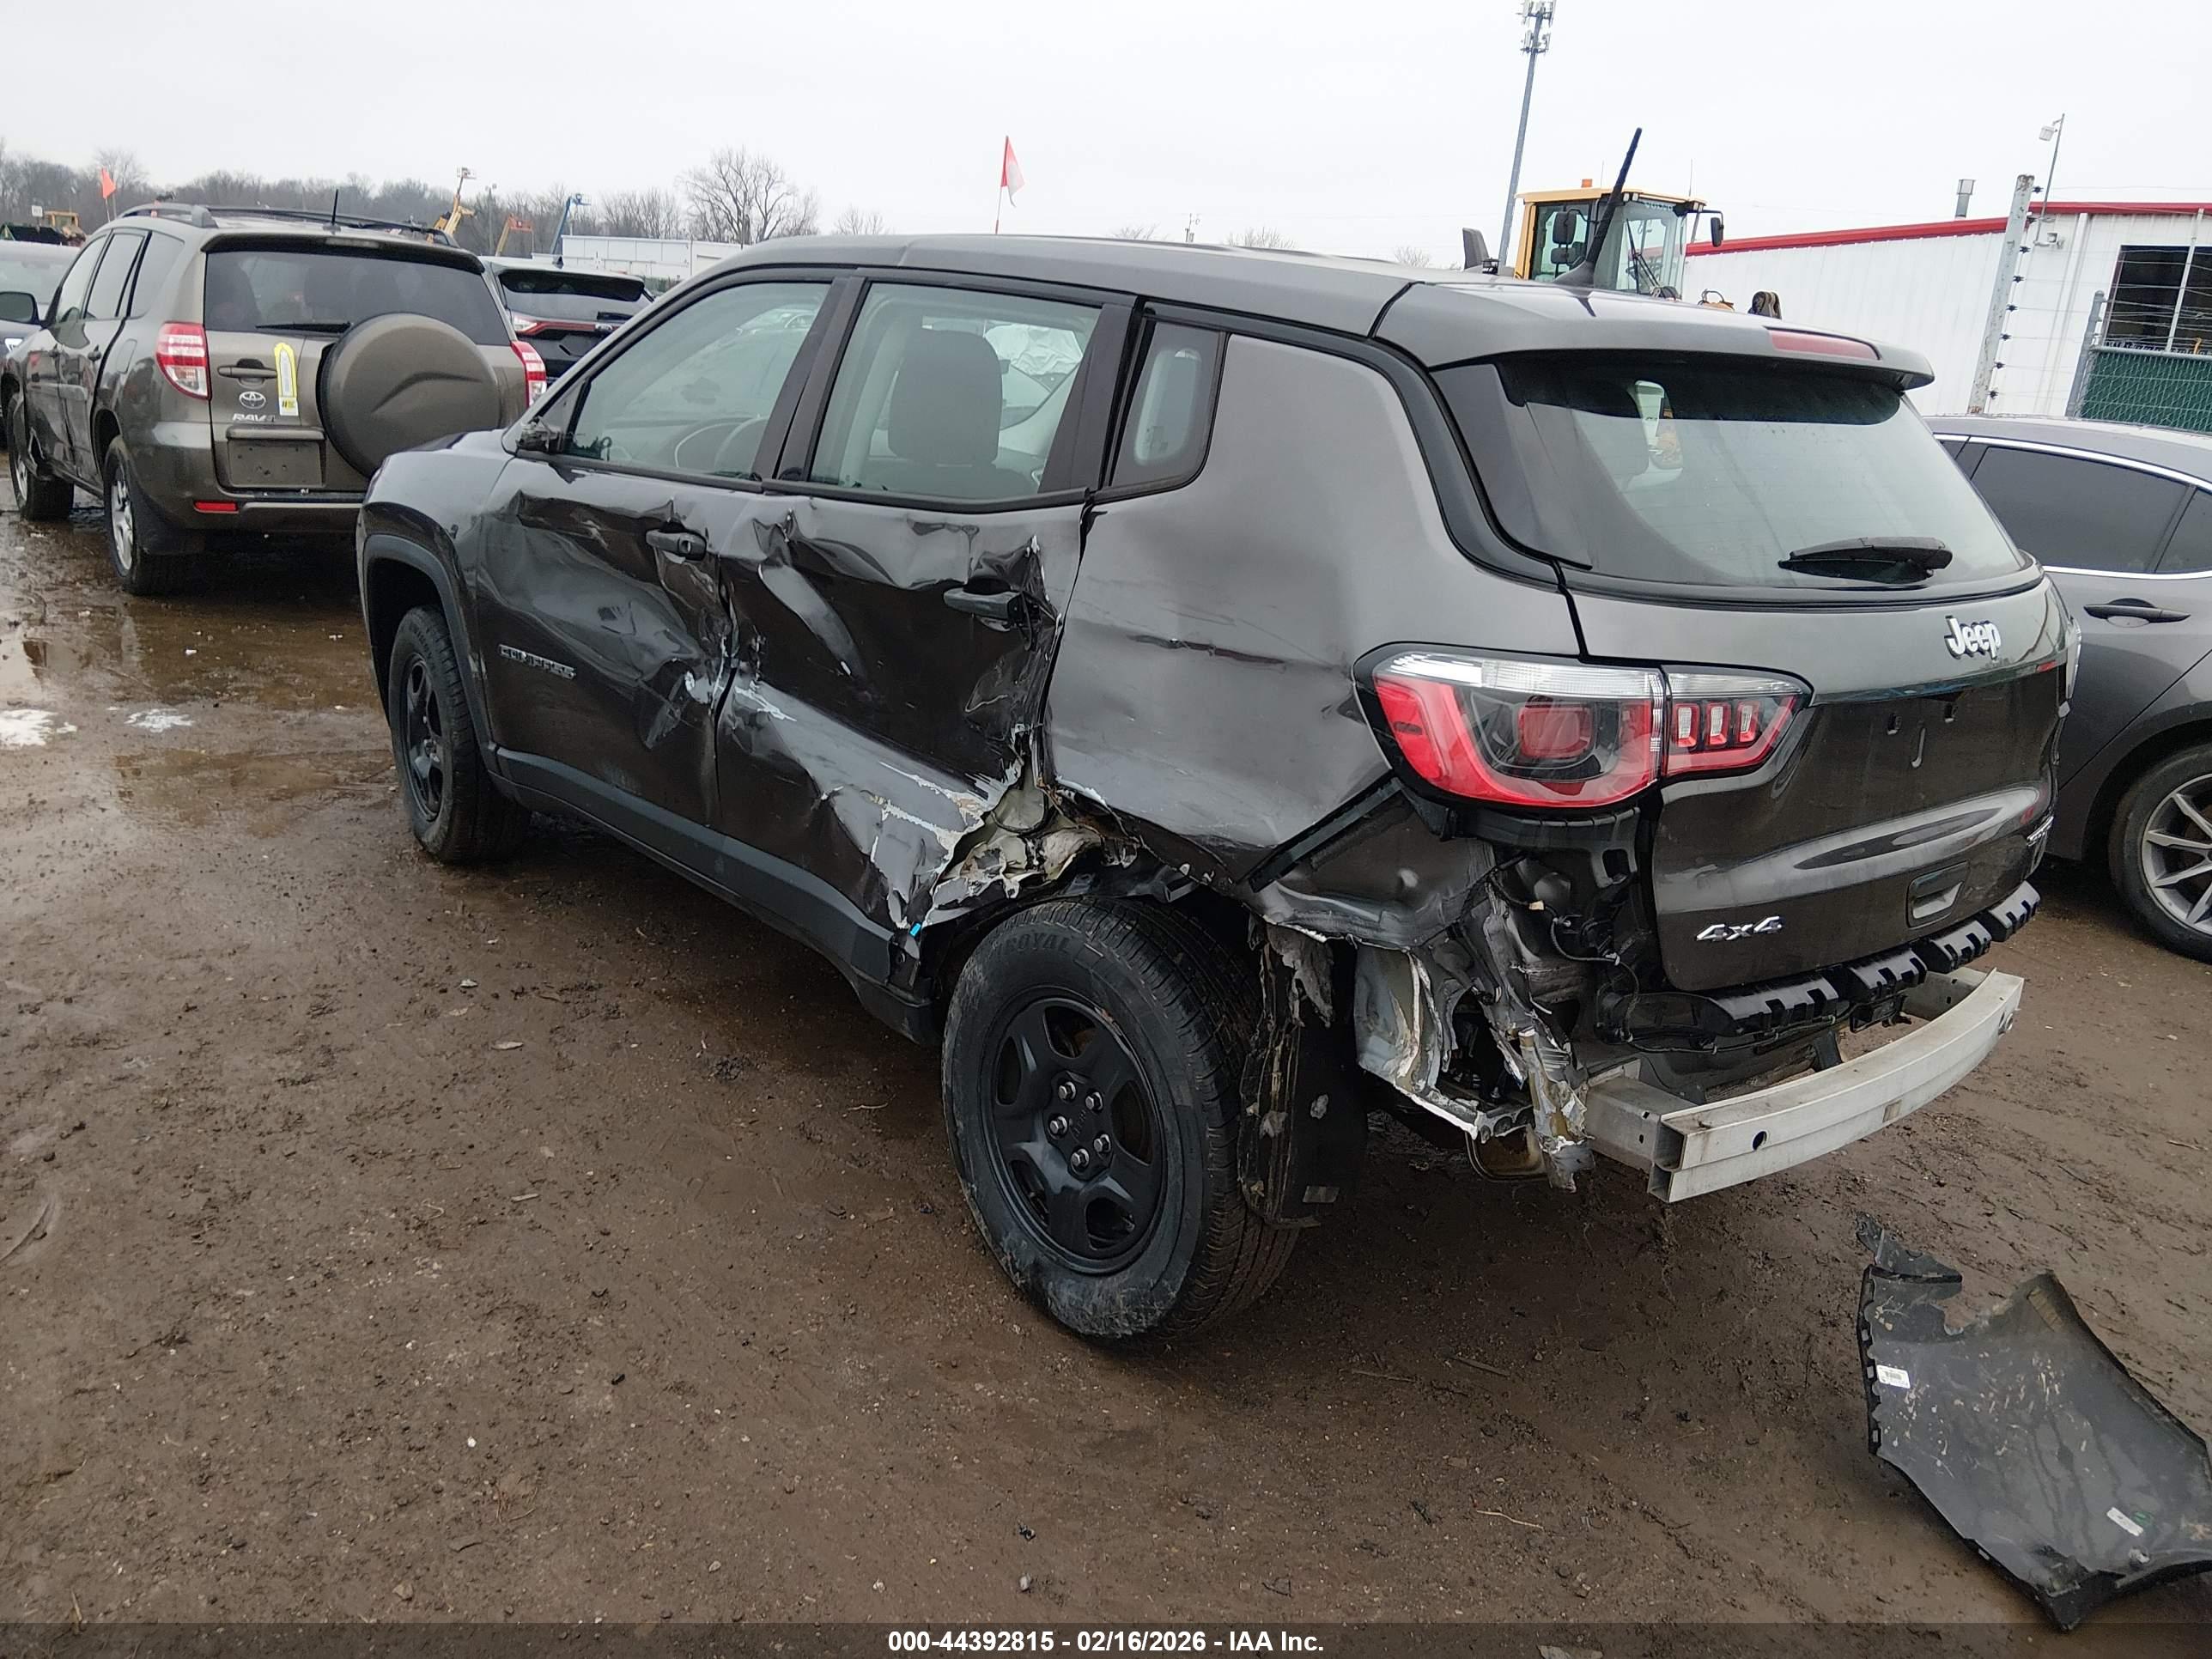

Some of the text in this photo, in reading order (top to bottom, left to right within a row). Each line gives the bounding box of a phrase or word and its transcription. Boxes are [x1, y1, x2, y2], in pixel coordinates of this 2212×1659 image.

[233, 413, 275, 422] RAV4
[1943, 615, 2002, 659] Jeep
[1696, 915, 1783, 942] 4x4
